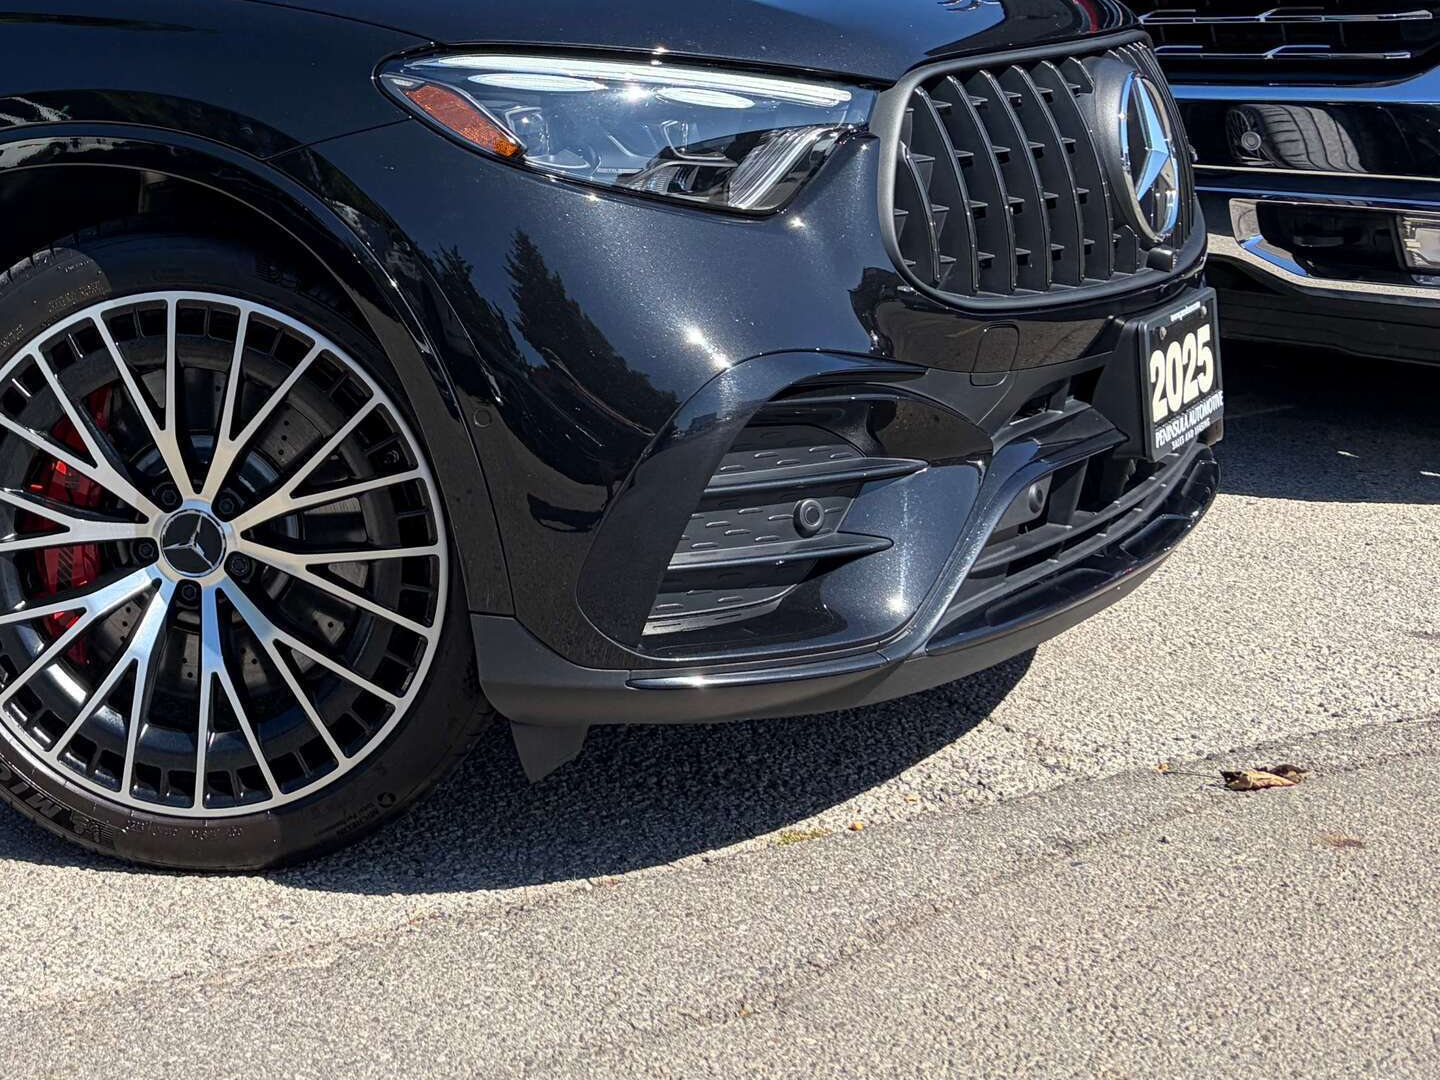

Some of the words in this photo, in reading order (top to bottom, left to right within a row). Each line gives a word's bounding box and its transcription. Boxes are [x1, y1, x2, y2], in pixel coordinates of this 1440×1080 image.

[1150, 323, 1214, 423] 2025
[1155, 413, 1189, 449] PENINSULA
[1187, 390, 1224, 428] AUTOMOTIVE
